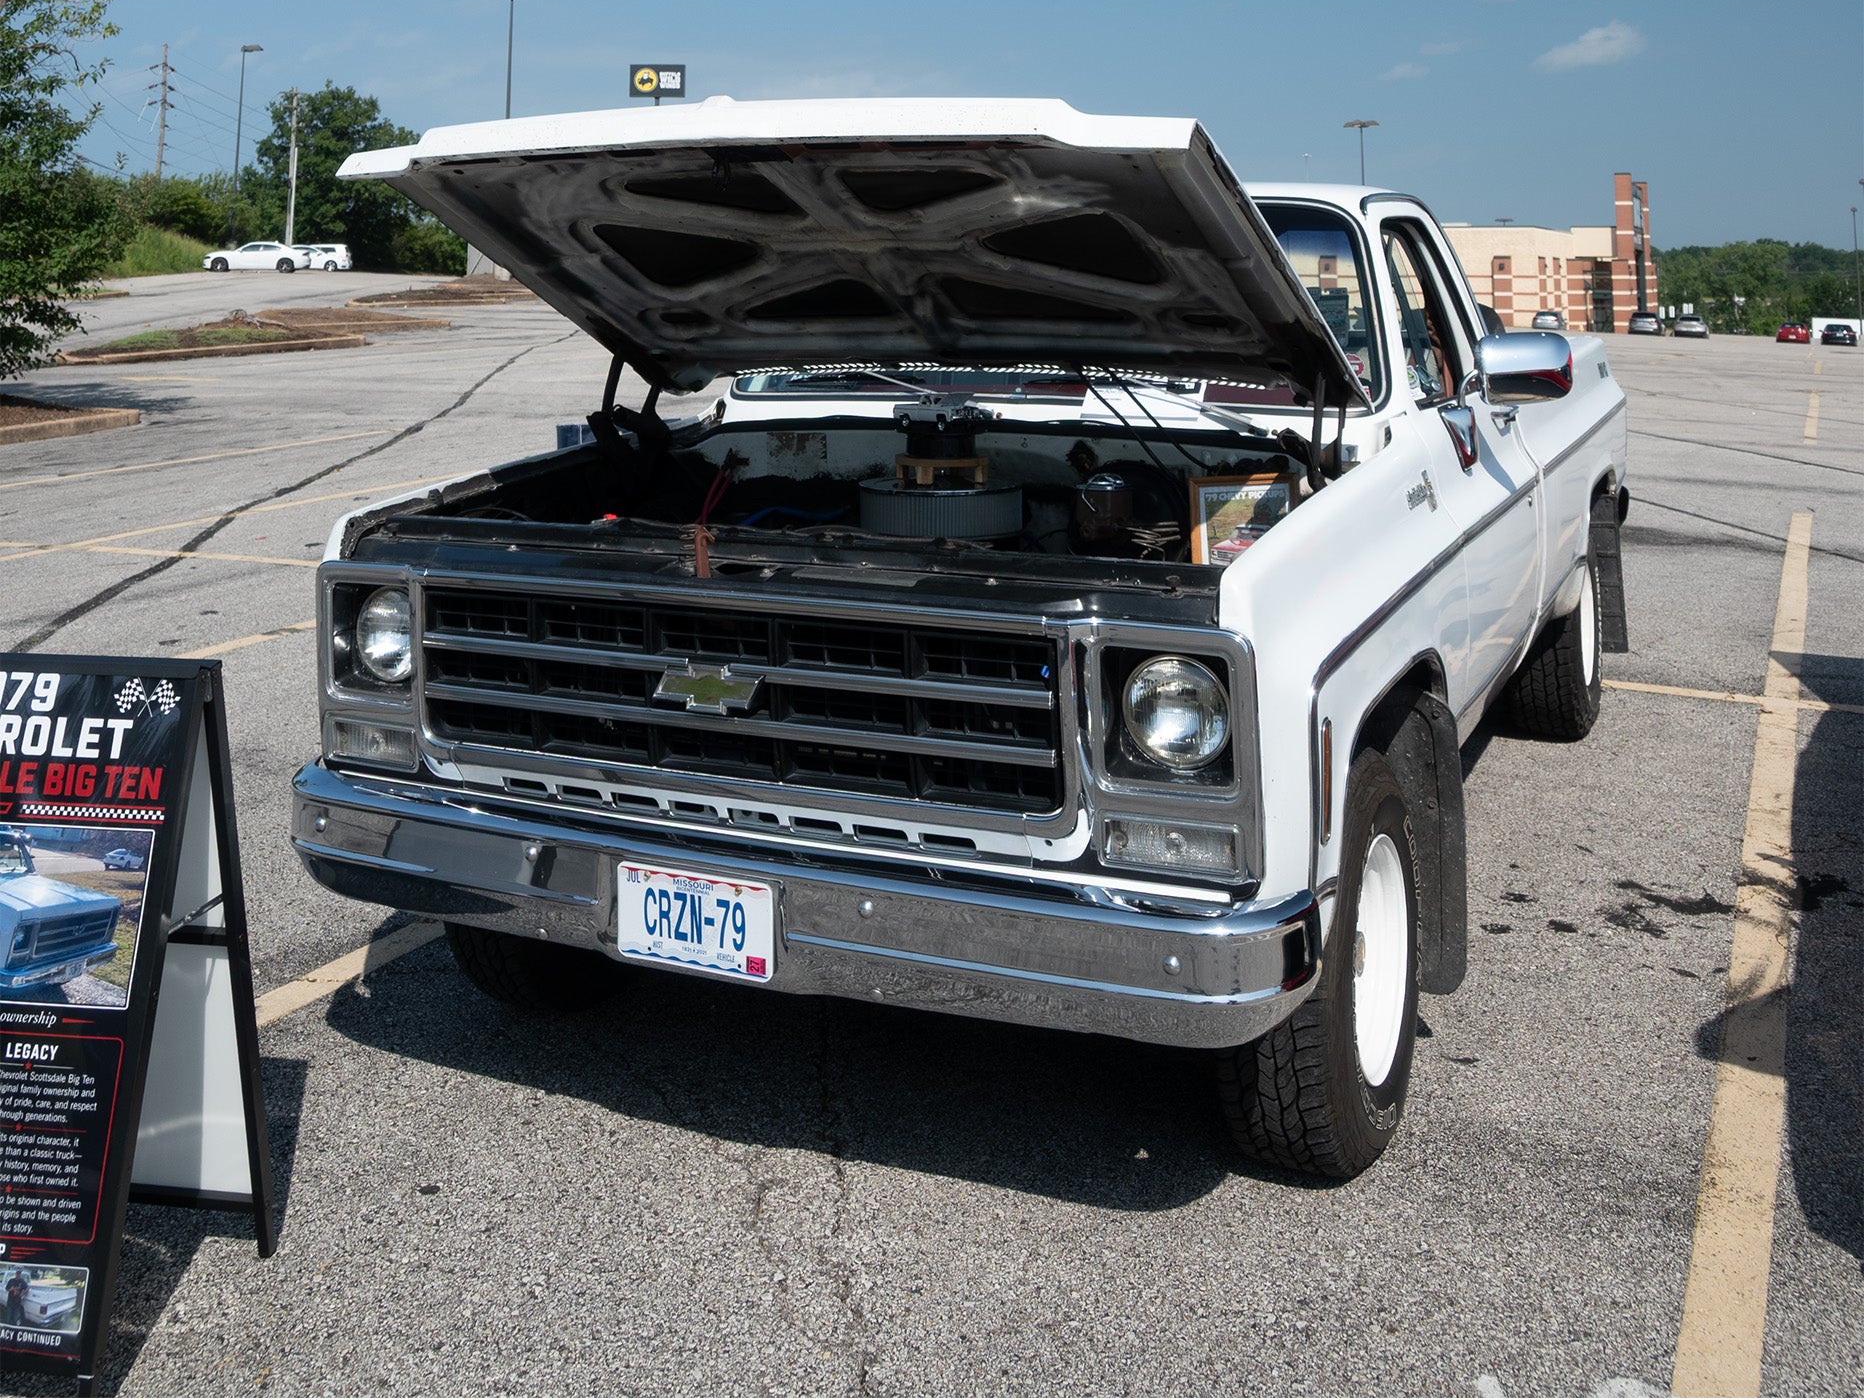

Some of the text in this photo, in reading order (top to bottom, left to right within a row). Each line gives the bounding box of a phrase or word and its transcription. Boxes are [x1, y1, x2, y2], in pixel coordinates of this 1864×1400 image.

[1219, 491, 1247, 501] CHEVY
[1248, 490, 1285, 500] PICKUPS
[0, 671, 61, 712] 79
[43, 762, 97, 798] BIG
[104, 765, 163, 800] TEN
[626, 870, 641, 884] JUL
[672, 878, 714, 892] MISSOURI
[643, 887, 746, 952] CRZN-79
[0, 1011, 57, 1028] ownership
[5, 1042, 59, 1061] LEGACY
[0, 1070, 95, 1086] hevrolet Scottsdale Big Ten
[20, 1084, 42, 1097] family
[43, 1086, 79, 1099] ownership
[81, 1089, 96, 1098] and
[5, 1096, 13, 1106] of
[13, 1097, 34, 1108] pride,
[35, 1101, 52, 1109] care,
[54, 1101, 69, 1110] and
[70, 1102, 97, 1113] respect
[25, 1111, 68, 1123] generations.
[9, 1132, 36, 1145] original
[37, 1135, 71, 1148] character,
[73, 1138, 80, 1147] it
[5, 1146, 22, 1156] than
[23, 1149, 28, 1157] a
[30, 1148, 54, 1159] classic
[4, 1159, 30, 1172] history,
[32, 1163, 62, 1175] memory,
[64, 1164, 80, 1174] and
[13, 1174, 28, 1184] who
[30, 1174, 44, 1185] first
[45, 1177, 69, 1187] owned
[71, 1177, 79, 1187] it.
[6, 1195, 16, 1205] be
[18, 1196, 41, 1206] shown
[42, 1198, 57, 1208] and
[58, 1199, 82, 1209] driven
[21, 1210, 36, 1220] and
[38, 1211, 50, 1221] the
[51, 1212, 77, 1224] people
[2, 1221, 33, 1236] its story.
[16, 1330, 62, 1347] CONTINUED
